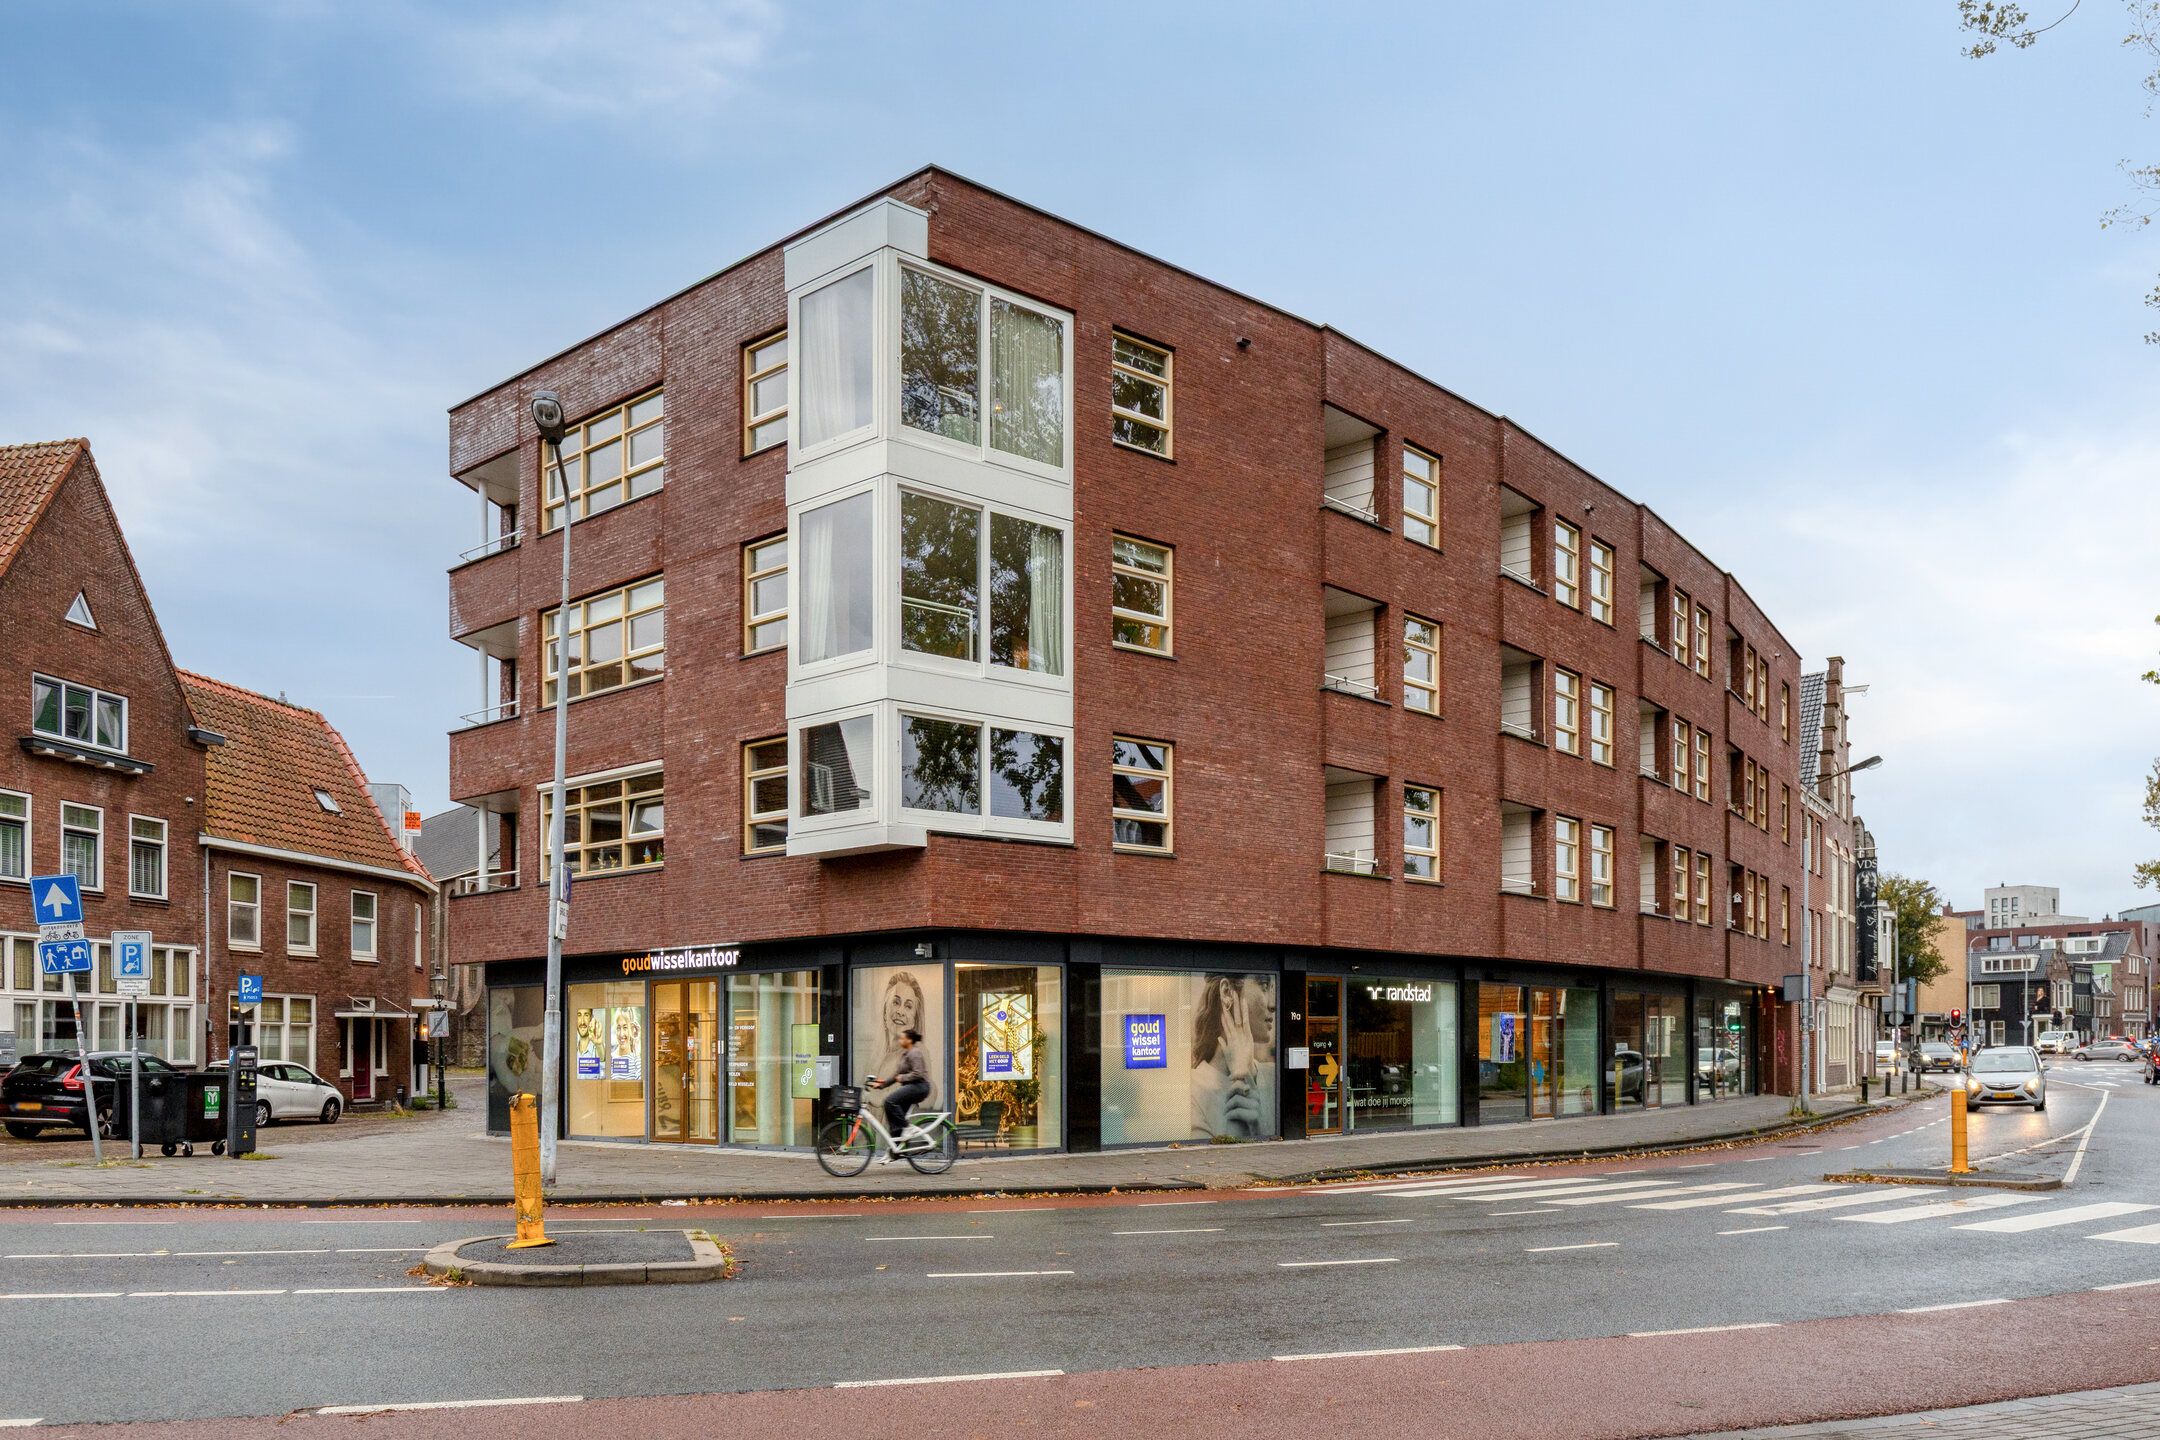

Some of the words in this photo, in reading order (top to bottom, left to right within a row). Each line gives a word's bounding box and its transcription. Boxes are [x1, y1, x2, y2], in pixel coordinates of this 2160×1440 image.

[1857, 859, 1877, 868] VDS
[126, 946, 138, 962] P
[622, 948, 740, 975] goudwisselkantoor
[241, 977, 252, 993] P
[1386, 983, 1432, 1001] randstad
[1131, 1020, 1160, 1036] goud
[1132, 1034, 1160, 1046] wissel
[1132, 1047, 1161, 1056] kantoor
[1354, 1099, 1366, 1107] wat
[1367, 1096, 1381, 1107] doe
